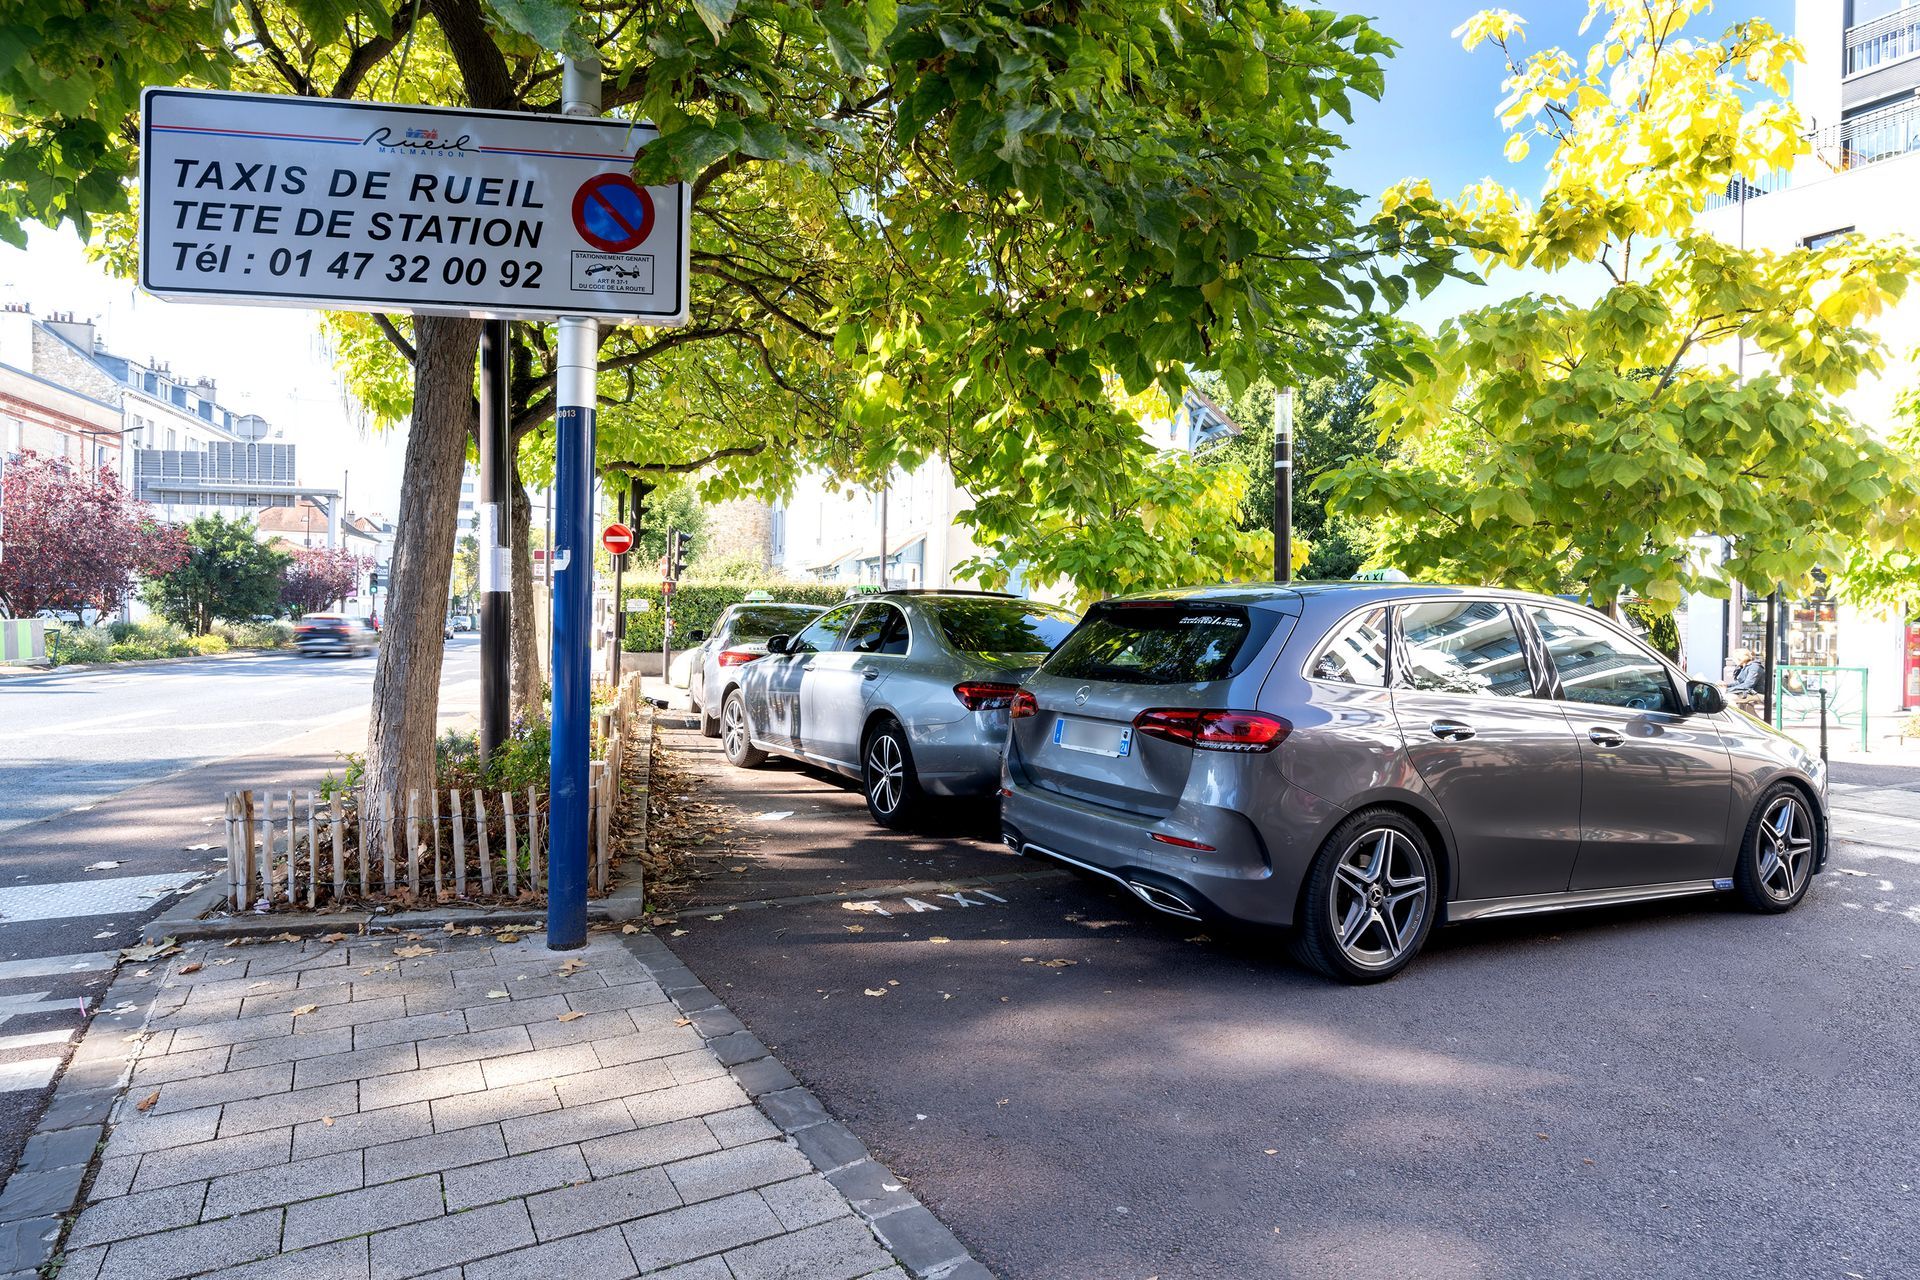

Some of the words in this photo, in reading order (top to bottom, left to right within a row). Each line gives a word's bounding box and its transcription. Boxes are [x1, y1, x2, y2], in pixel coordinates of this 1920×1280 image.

[363, 127, 480, 153] Rueil
[379, 147, 464, 158] MALMAISON
[173, 158, 308, 195] TAXIS
[328, 169, 391, 200] DE
[408, 173, 544, 209] RUEIL
[172, 200, 283, 235] TETE
[294, 207, 355, 239] DE
[367, 211, 544, 249] STATION
[172, 242, 232, 273] Tél
[269, 247, 313, 277] 01
[326, 251, 376, 280] 47
[385, 253, 431, 283] 32
[442, 256, 487, 286] 00
[498, 259, 543, 289] 92
[575, 253, 626, 261] STATIONNEMENT
[1356, 572, 1384, 581] TAXI
[860, 586, 882, 595] TAXI
[844, 889, 1008, 916] TAXI
